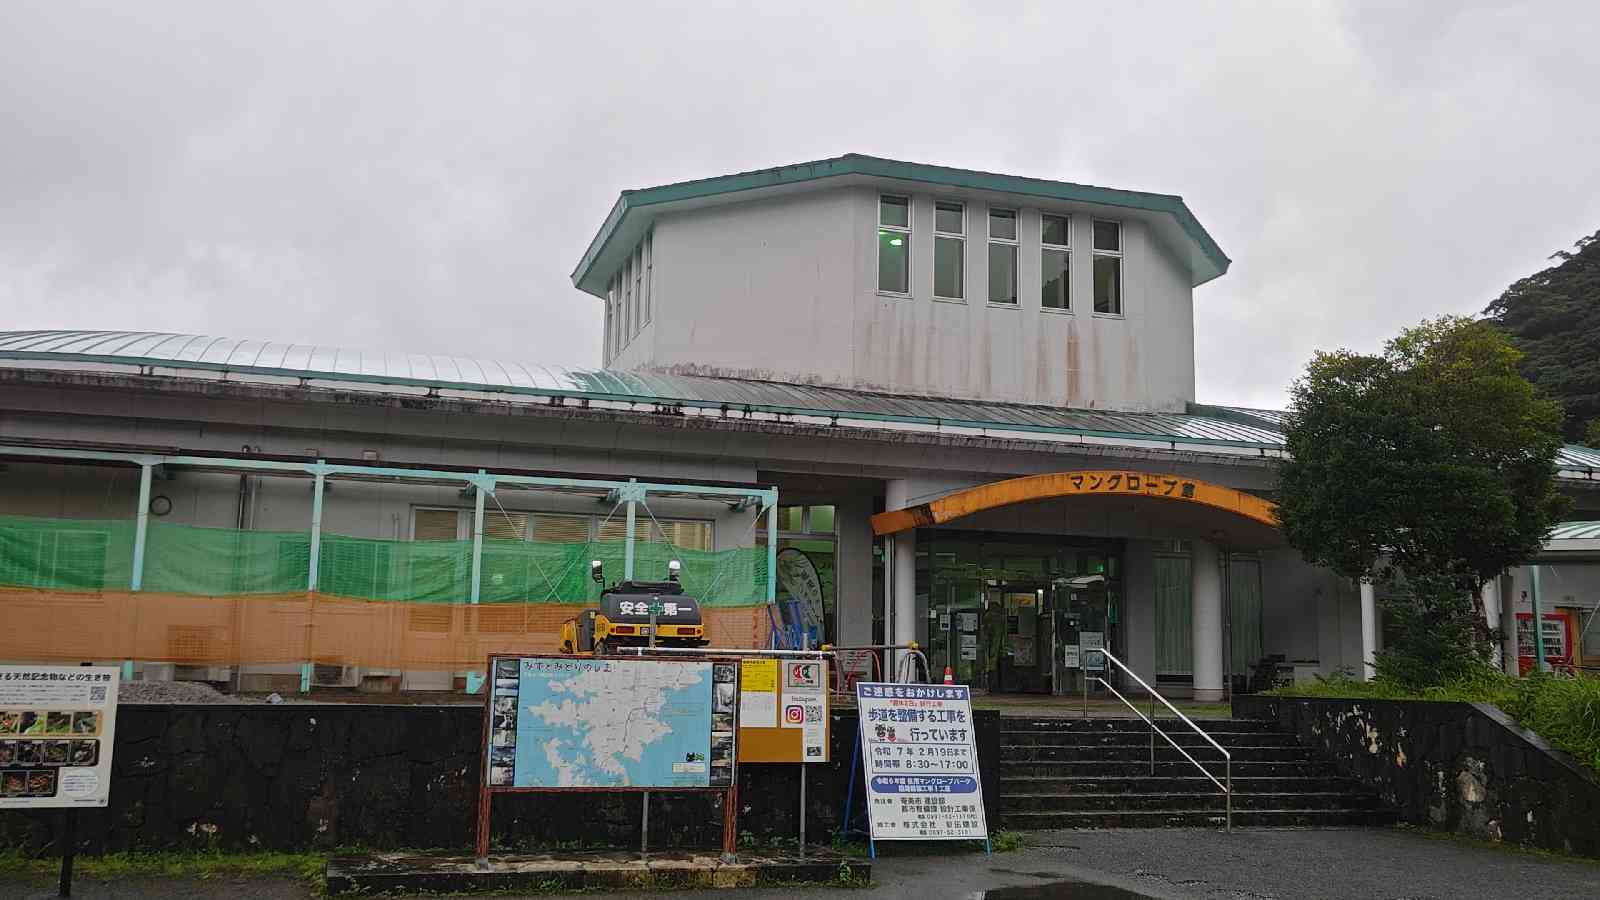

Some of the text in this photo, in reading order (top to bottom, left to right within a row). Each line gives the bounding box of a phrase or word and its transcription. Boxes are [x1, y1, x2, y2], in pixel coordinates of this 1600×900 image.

[0, 672, 111, 681] る天然記念物などの生き物
[863, 686, 964, 698] ご迷惑をおかけします
[868, 708, 966, 723] 歩道を整備する工事を
[910, 728, 967, 741] 行っています
